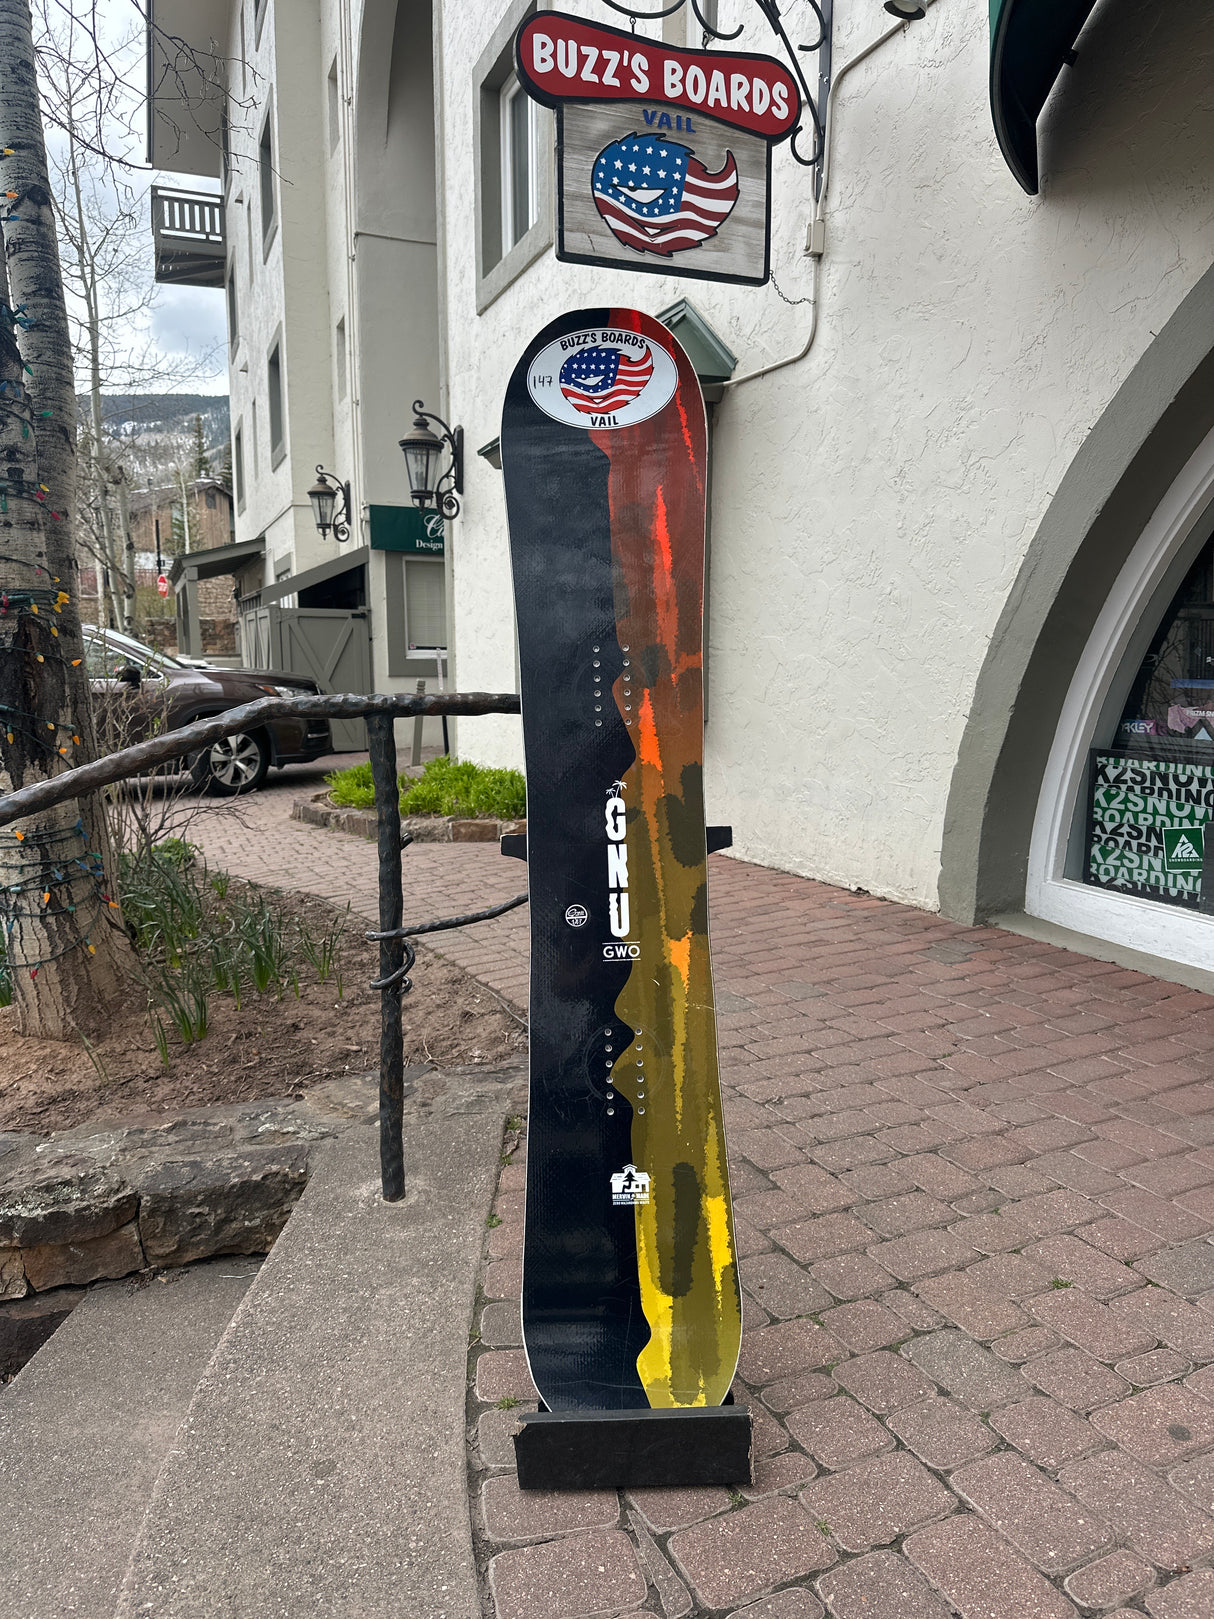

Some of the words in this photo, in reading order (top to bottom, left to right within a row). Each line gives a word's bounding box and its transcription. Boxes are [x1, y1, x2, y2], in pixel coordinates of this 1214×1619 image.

[532, 33, 650, 94] BUZZ'S
[663, 60, 790, 120] BOARDS
[642, 109, 696, 134] VAIL
[559, 332, 598, 351] BUZZ'S
[601, 331, 646, 350] BOARDS
[533, 375, 553, 389] 147
[590, 415, 620, 427] VAIL
[415, 539, 443, 551] Design
[602, 944, 641, 959] GWO
